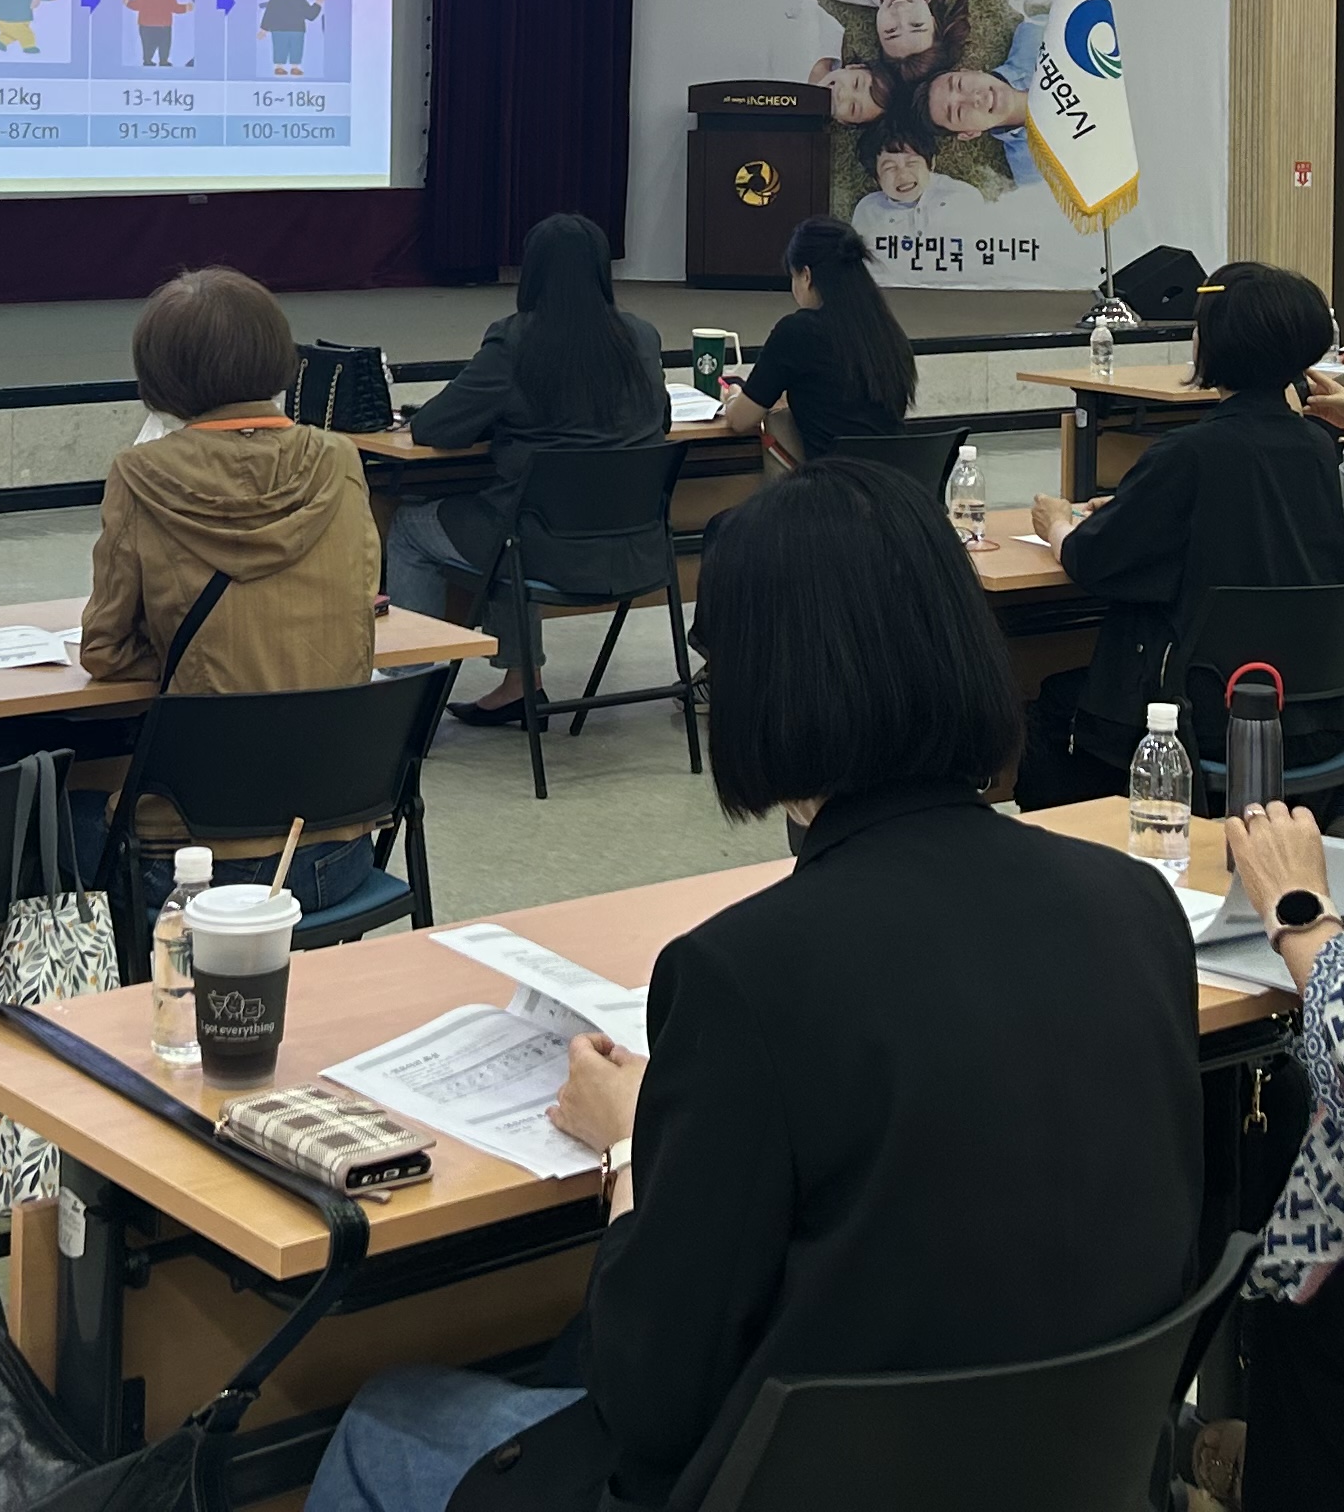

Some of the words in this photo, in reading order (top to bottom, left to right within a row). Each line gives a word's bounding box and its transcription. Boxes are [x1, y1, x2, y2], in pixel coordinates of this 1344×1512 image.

[121, 88, 196, 112] 13-14kg
[252, 90, 328, 113] 16~18kg
[746, 95, 797, 106] INCHEON
[117, 122, 198, 141] 91-95cm
[240, 122, 337, 141] 100-105cm
[875, 233, 964, 272] 대한민국
[975, 235, 1041, 267] 입니다
[205, 1022, 218, 1035] got
[219, 1021, 275, 1038] everything
